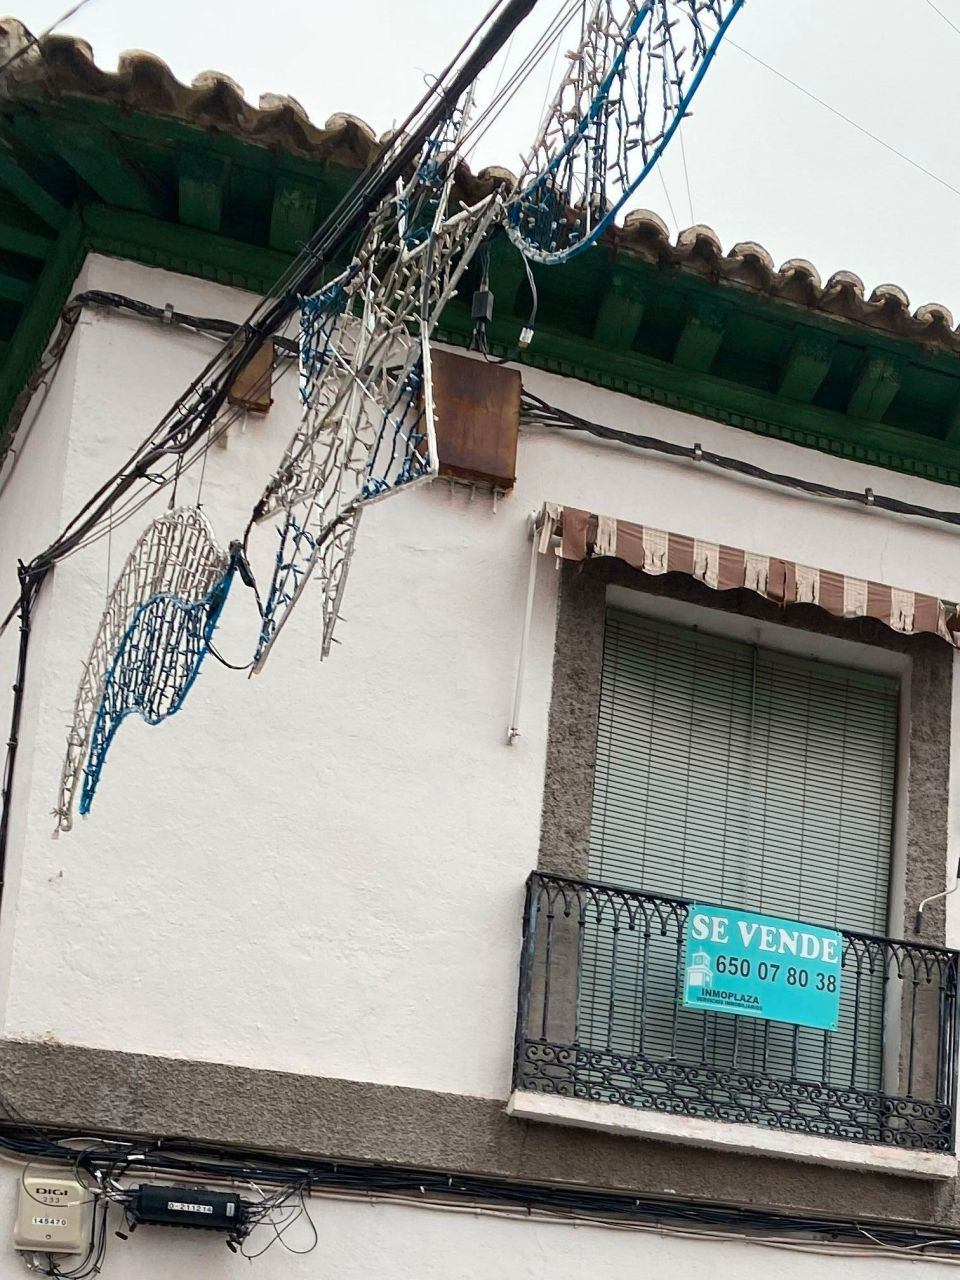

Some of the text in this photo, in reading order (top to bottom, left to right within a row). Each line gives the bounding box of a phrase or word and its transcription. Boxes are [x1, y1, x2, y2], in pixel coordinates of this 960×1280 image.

[691, 914, 839, 963] SE VENDE
[716, 955, 837, 993] 650 07 80 38
[701, 988, 760, 1005] INMOPLAZA
[36, 1188, 68, 1196] DIGI
